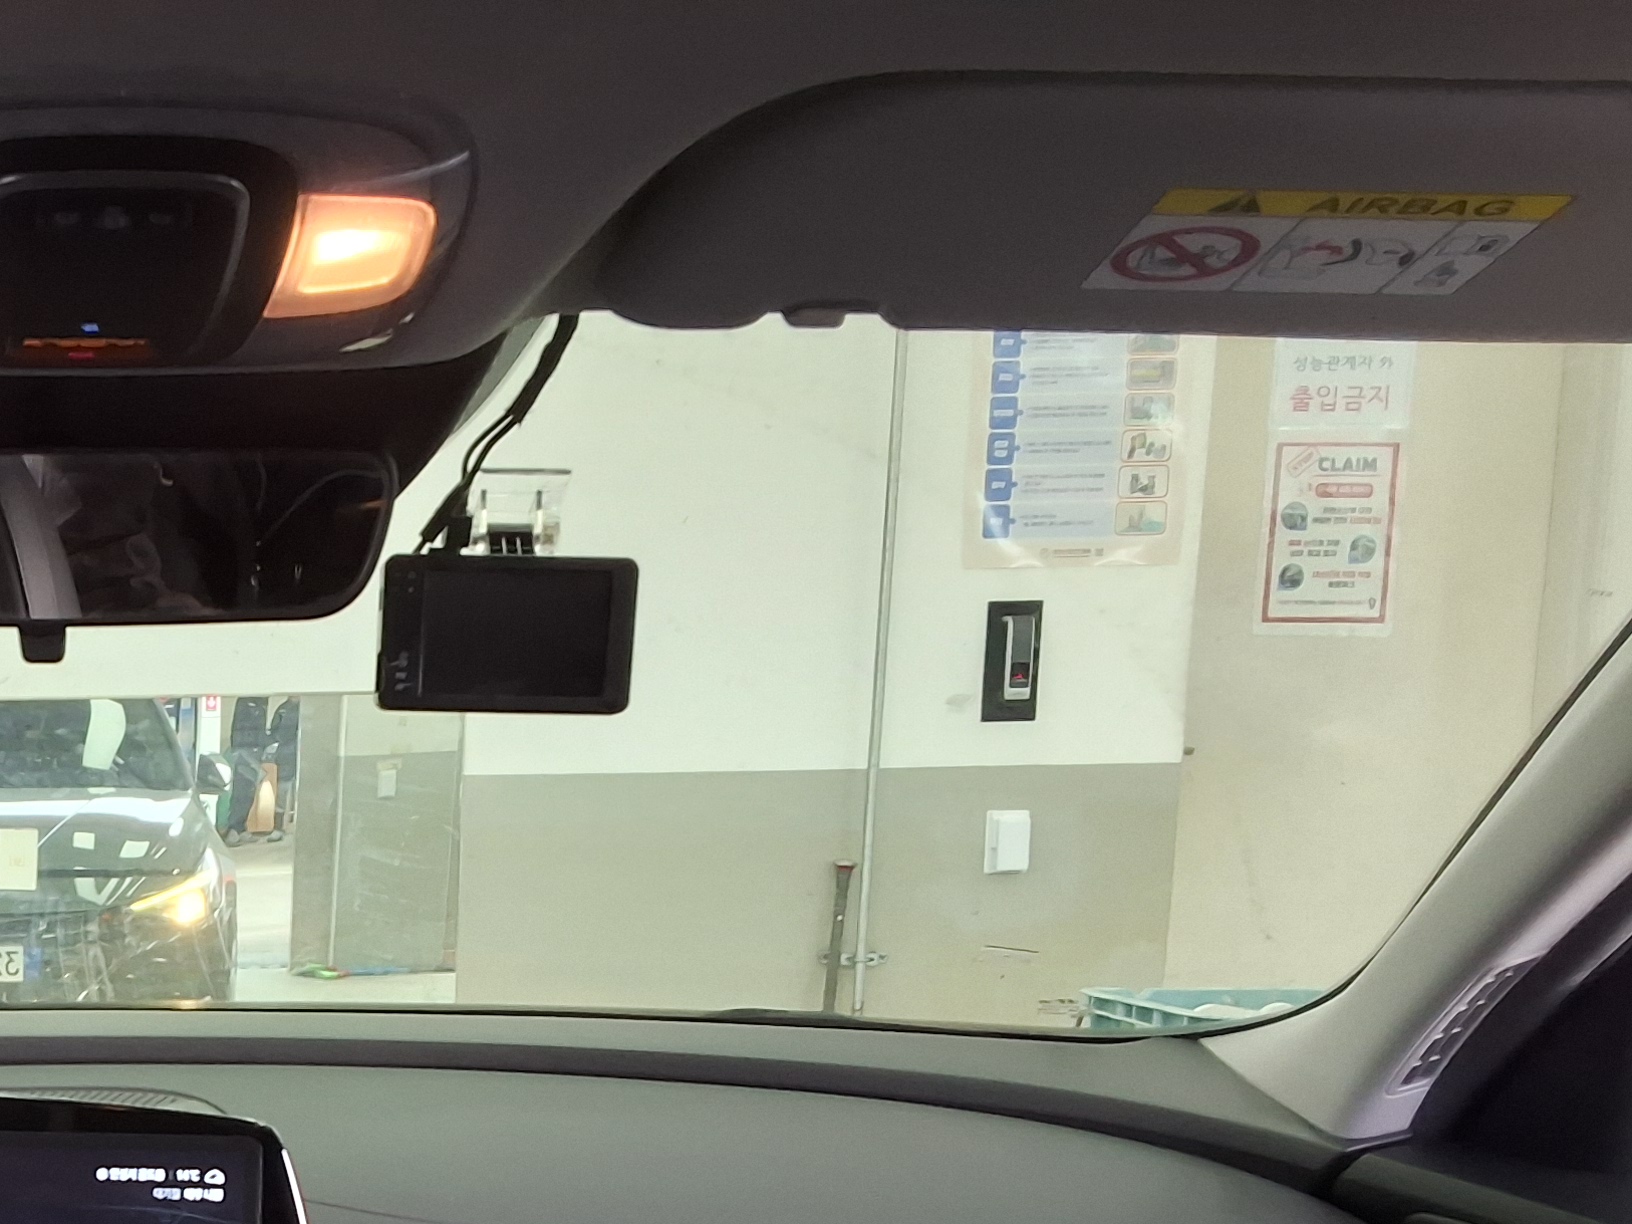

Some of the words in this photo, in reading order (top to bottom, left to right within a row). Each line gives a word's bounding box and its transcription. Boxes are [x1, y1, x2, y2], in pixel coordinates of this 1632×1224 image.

[1306, 195, 1515, 217] AIRBAG
[1290, 384, 1391, 412] 출입금지
[1318, 456, 1378, 473] CLAIM
